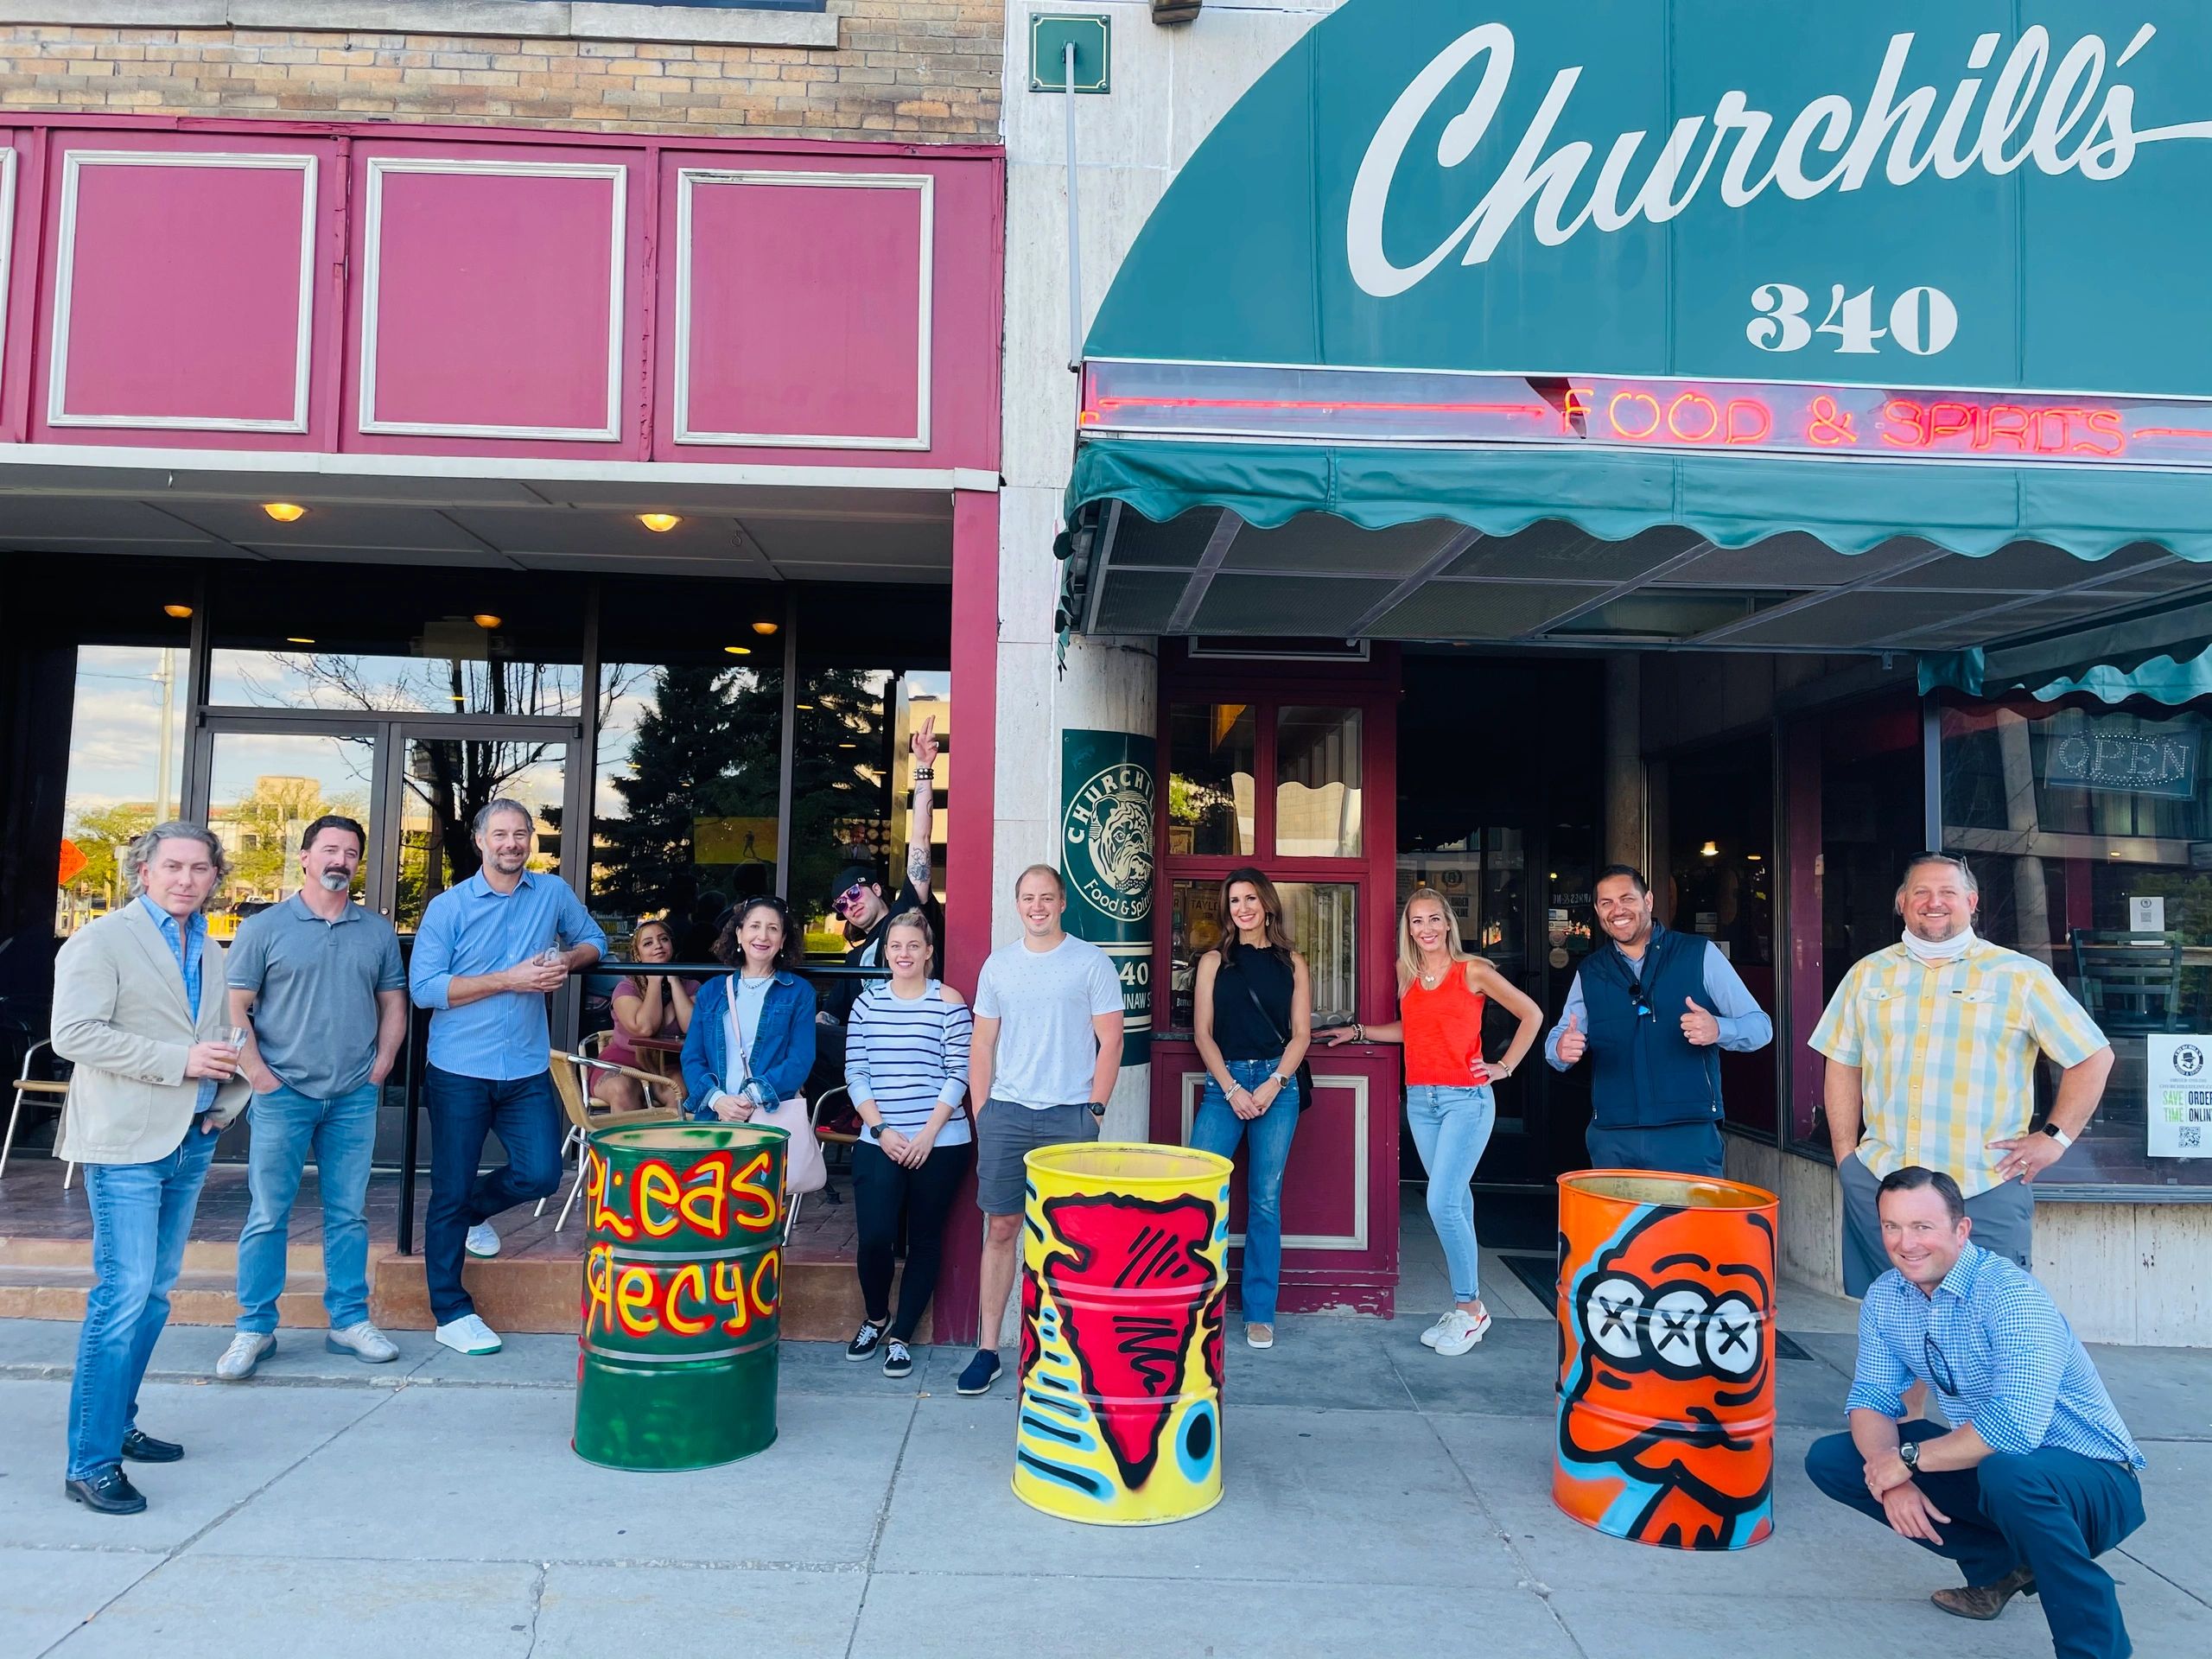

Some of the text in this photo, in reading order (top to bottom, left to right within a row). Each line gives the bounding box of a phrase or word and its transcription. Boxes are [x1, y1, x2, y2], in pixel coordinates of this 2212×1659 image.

[1346, 22, 2158, 296] Churchill's
[1746, 283, 1958, 355] 340
[1561, 388, 2126, 455] FOOD & SPIRITS
[2058, 736, 2190, 779] OPEN
[1084, 878, 1119, 912] Food
[1121, 899, 1129, 915] &
[1119, 961, 1148, 986] 40
[2163, 1090, 2183, 1105] SAVE
[2163, 1108, 2183, 1122] TIME
